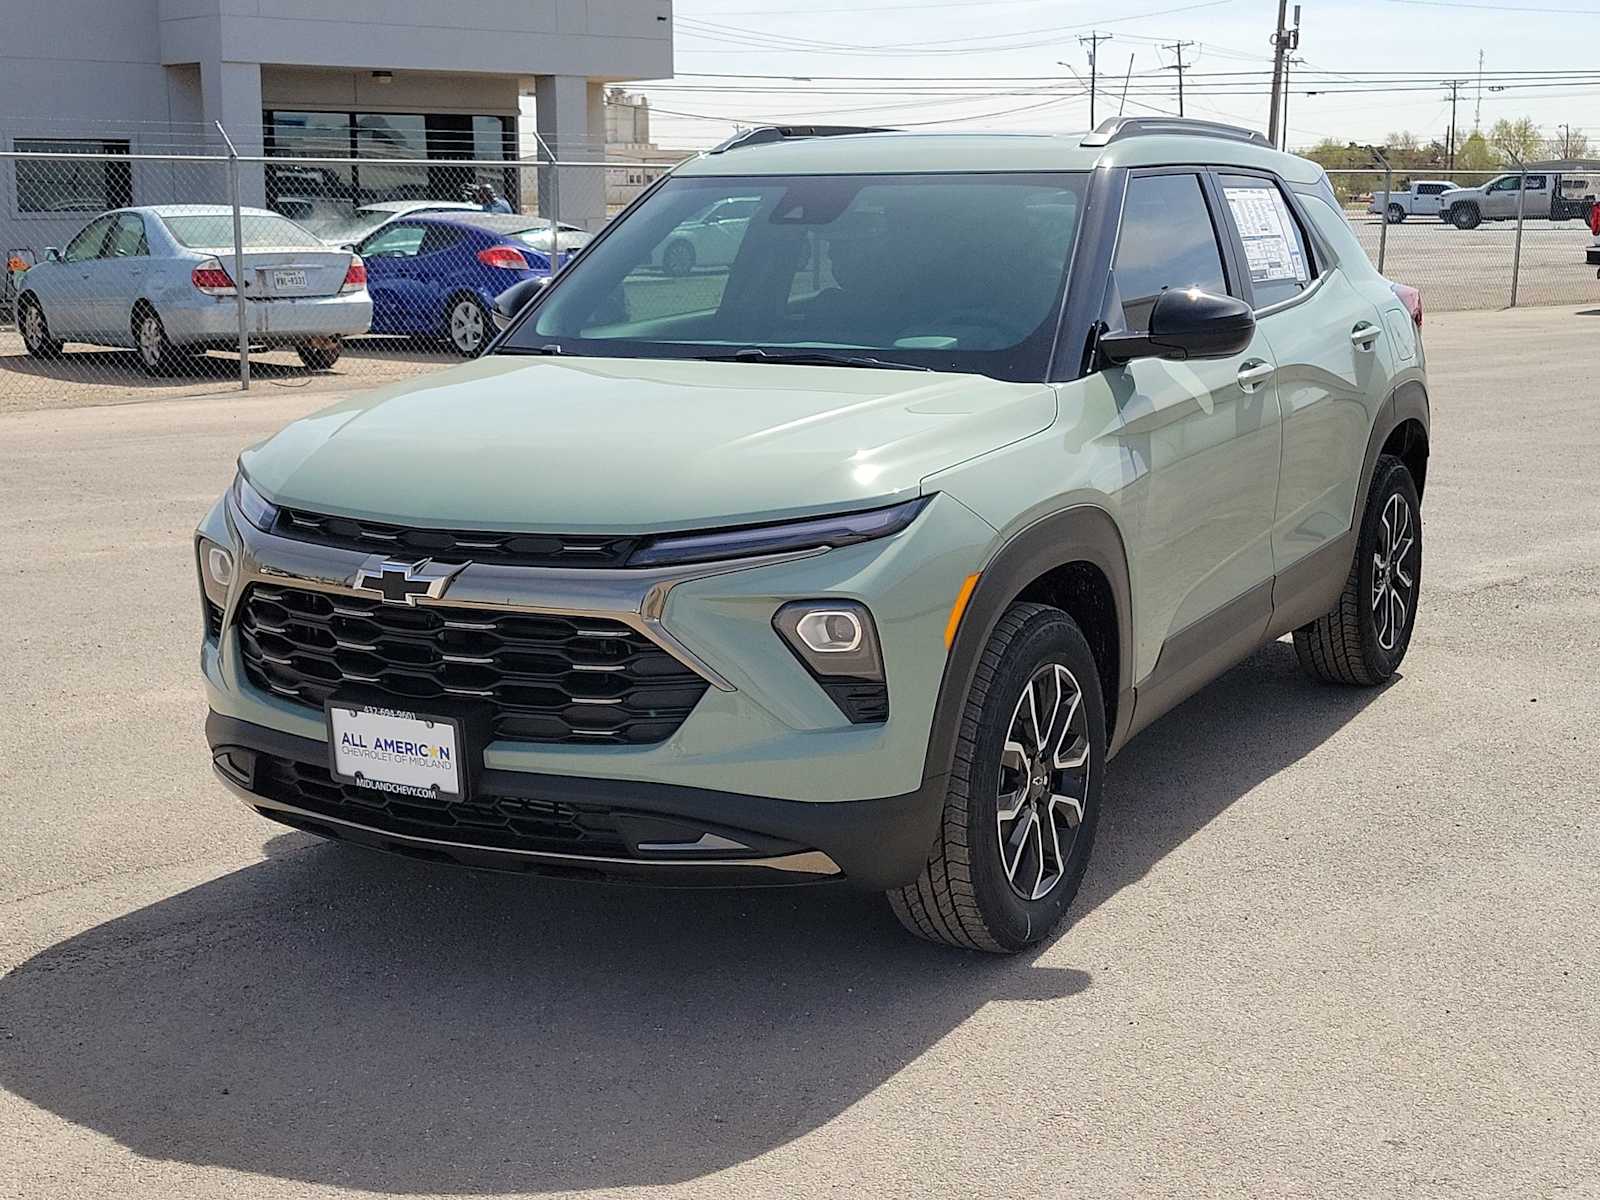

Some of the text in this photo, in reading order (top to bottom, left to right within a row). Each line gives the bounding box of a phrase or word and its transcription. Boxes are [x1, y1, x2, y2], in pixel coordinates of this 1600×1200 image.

[342, 731, 367, 749] ALL
[341, 746, 452, 771] CHEVROLET OF MIDLAND
[355, 777, 438, 800] MIDLANDCHEVY.COM
